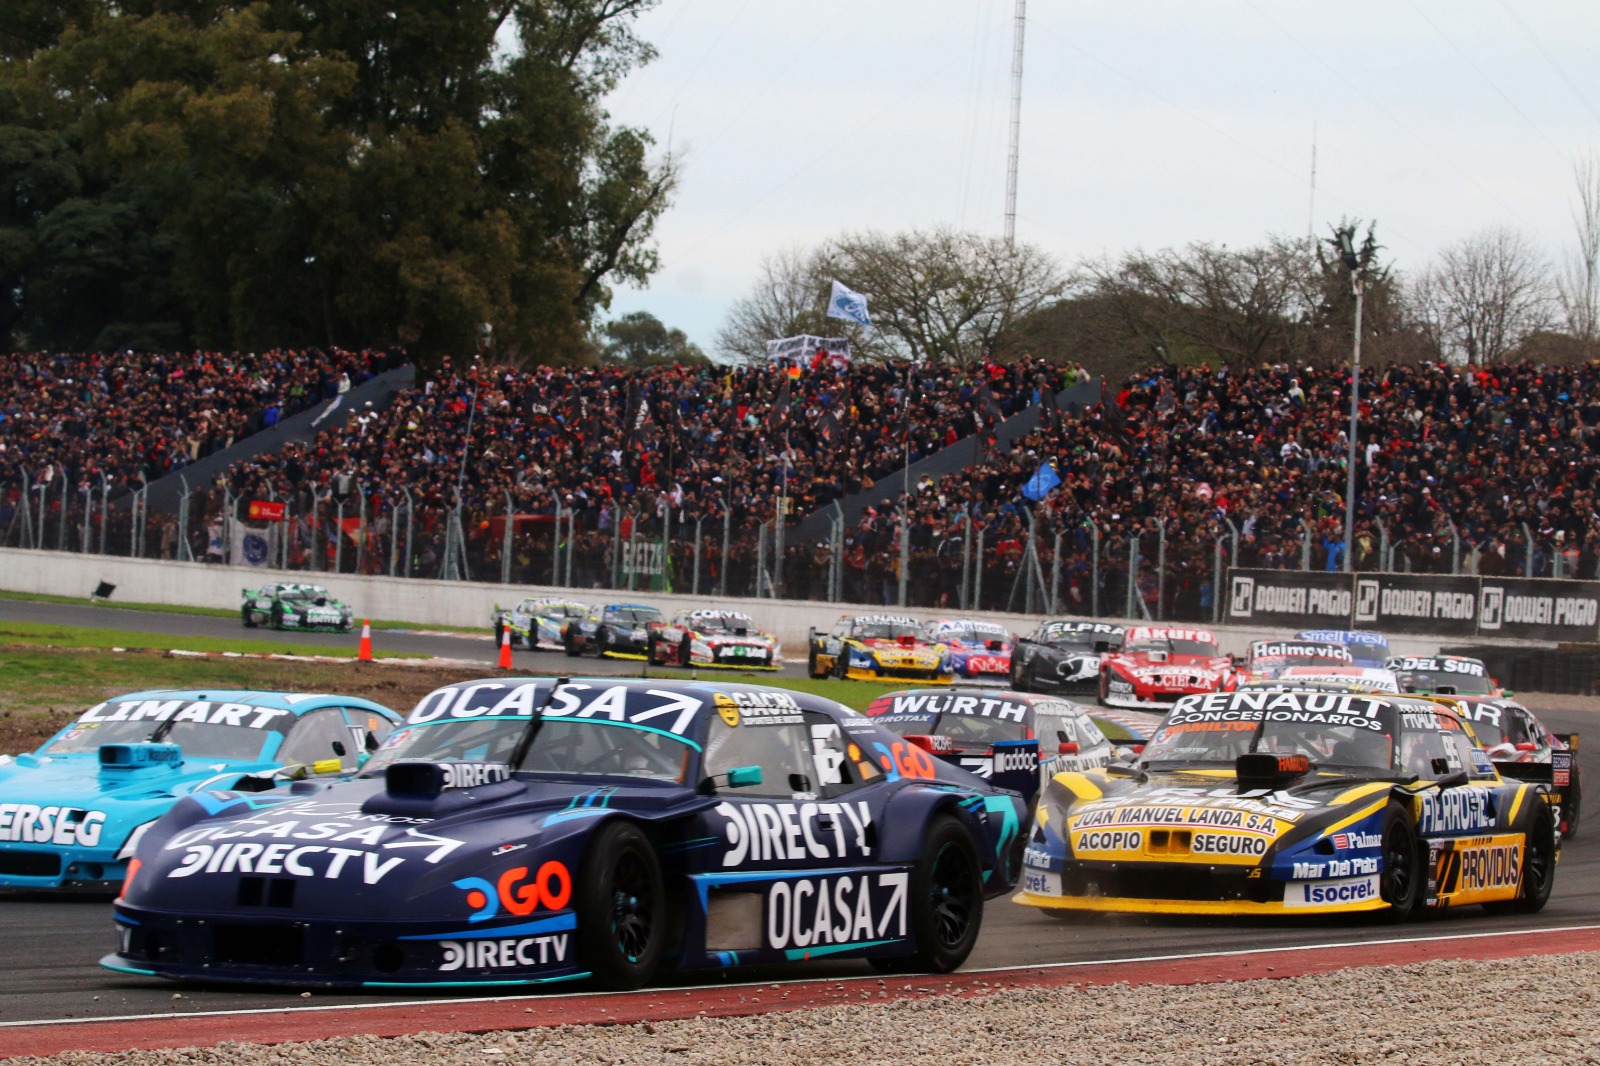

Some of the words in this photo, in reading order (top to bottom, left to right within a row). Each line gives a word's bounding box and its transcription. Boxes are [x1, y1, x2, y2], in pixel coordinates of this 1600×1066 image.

[854, 615, 921, 628] RENAULT
[1133, 627, 1212, 642] Akuro
[1301, 631, 1344, 644] Smell
[1347, 631, 1387, 647] Fresh
[1254, 643, 1352, 663] Haimovich
[1402, 655, 1440, 672] DEL
[1446, 658, 1484, 678] SUR
[406, 683, 628, 724] OCASA
[893, 695, 1027, 723] WÜRTH
[1170, 693, 1391, 719] RENAULT
[1165, 720, 1260, 735] HAMILTON
[1167, 708, 1383, 732] CONCESIONARIOS
[1074, 810, 1116, 829] JUAN
[1118, 807, 1185, 823] MANUEL
[1187, 808, 1243, 828] LANDA
[1246, 814, 1277, 834] S.A.
[714, 801, 872, 867] DIRECTV
[1077, 831, 1142, 851] ACOPIO
[1193, 833, 1267, 856] SEGURO
[167, 842, 406, 886] DIRECTV
[1292, 862, 1326, 879] Mar
[1328, 859, 1350, 877] Del
[1351, 857, 1378, 875] Plata
[1460, 845, 1520, 892] PROVIDUS
[767, 875, 875, 950] OCASA
[438, 933, 569, 972] DIRECTV
